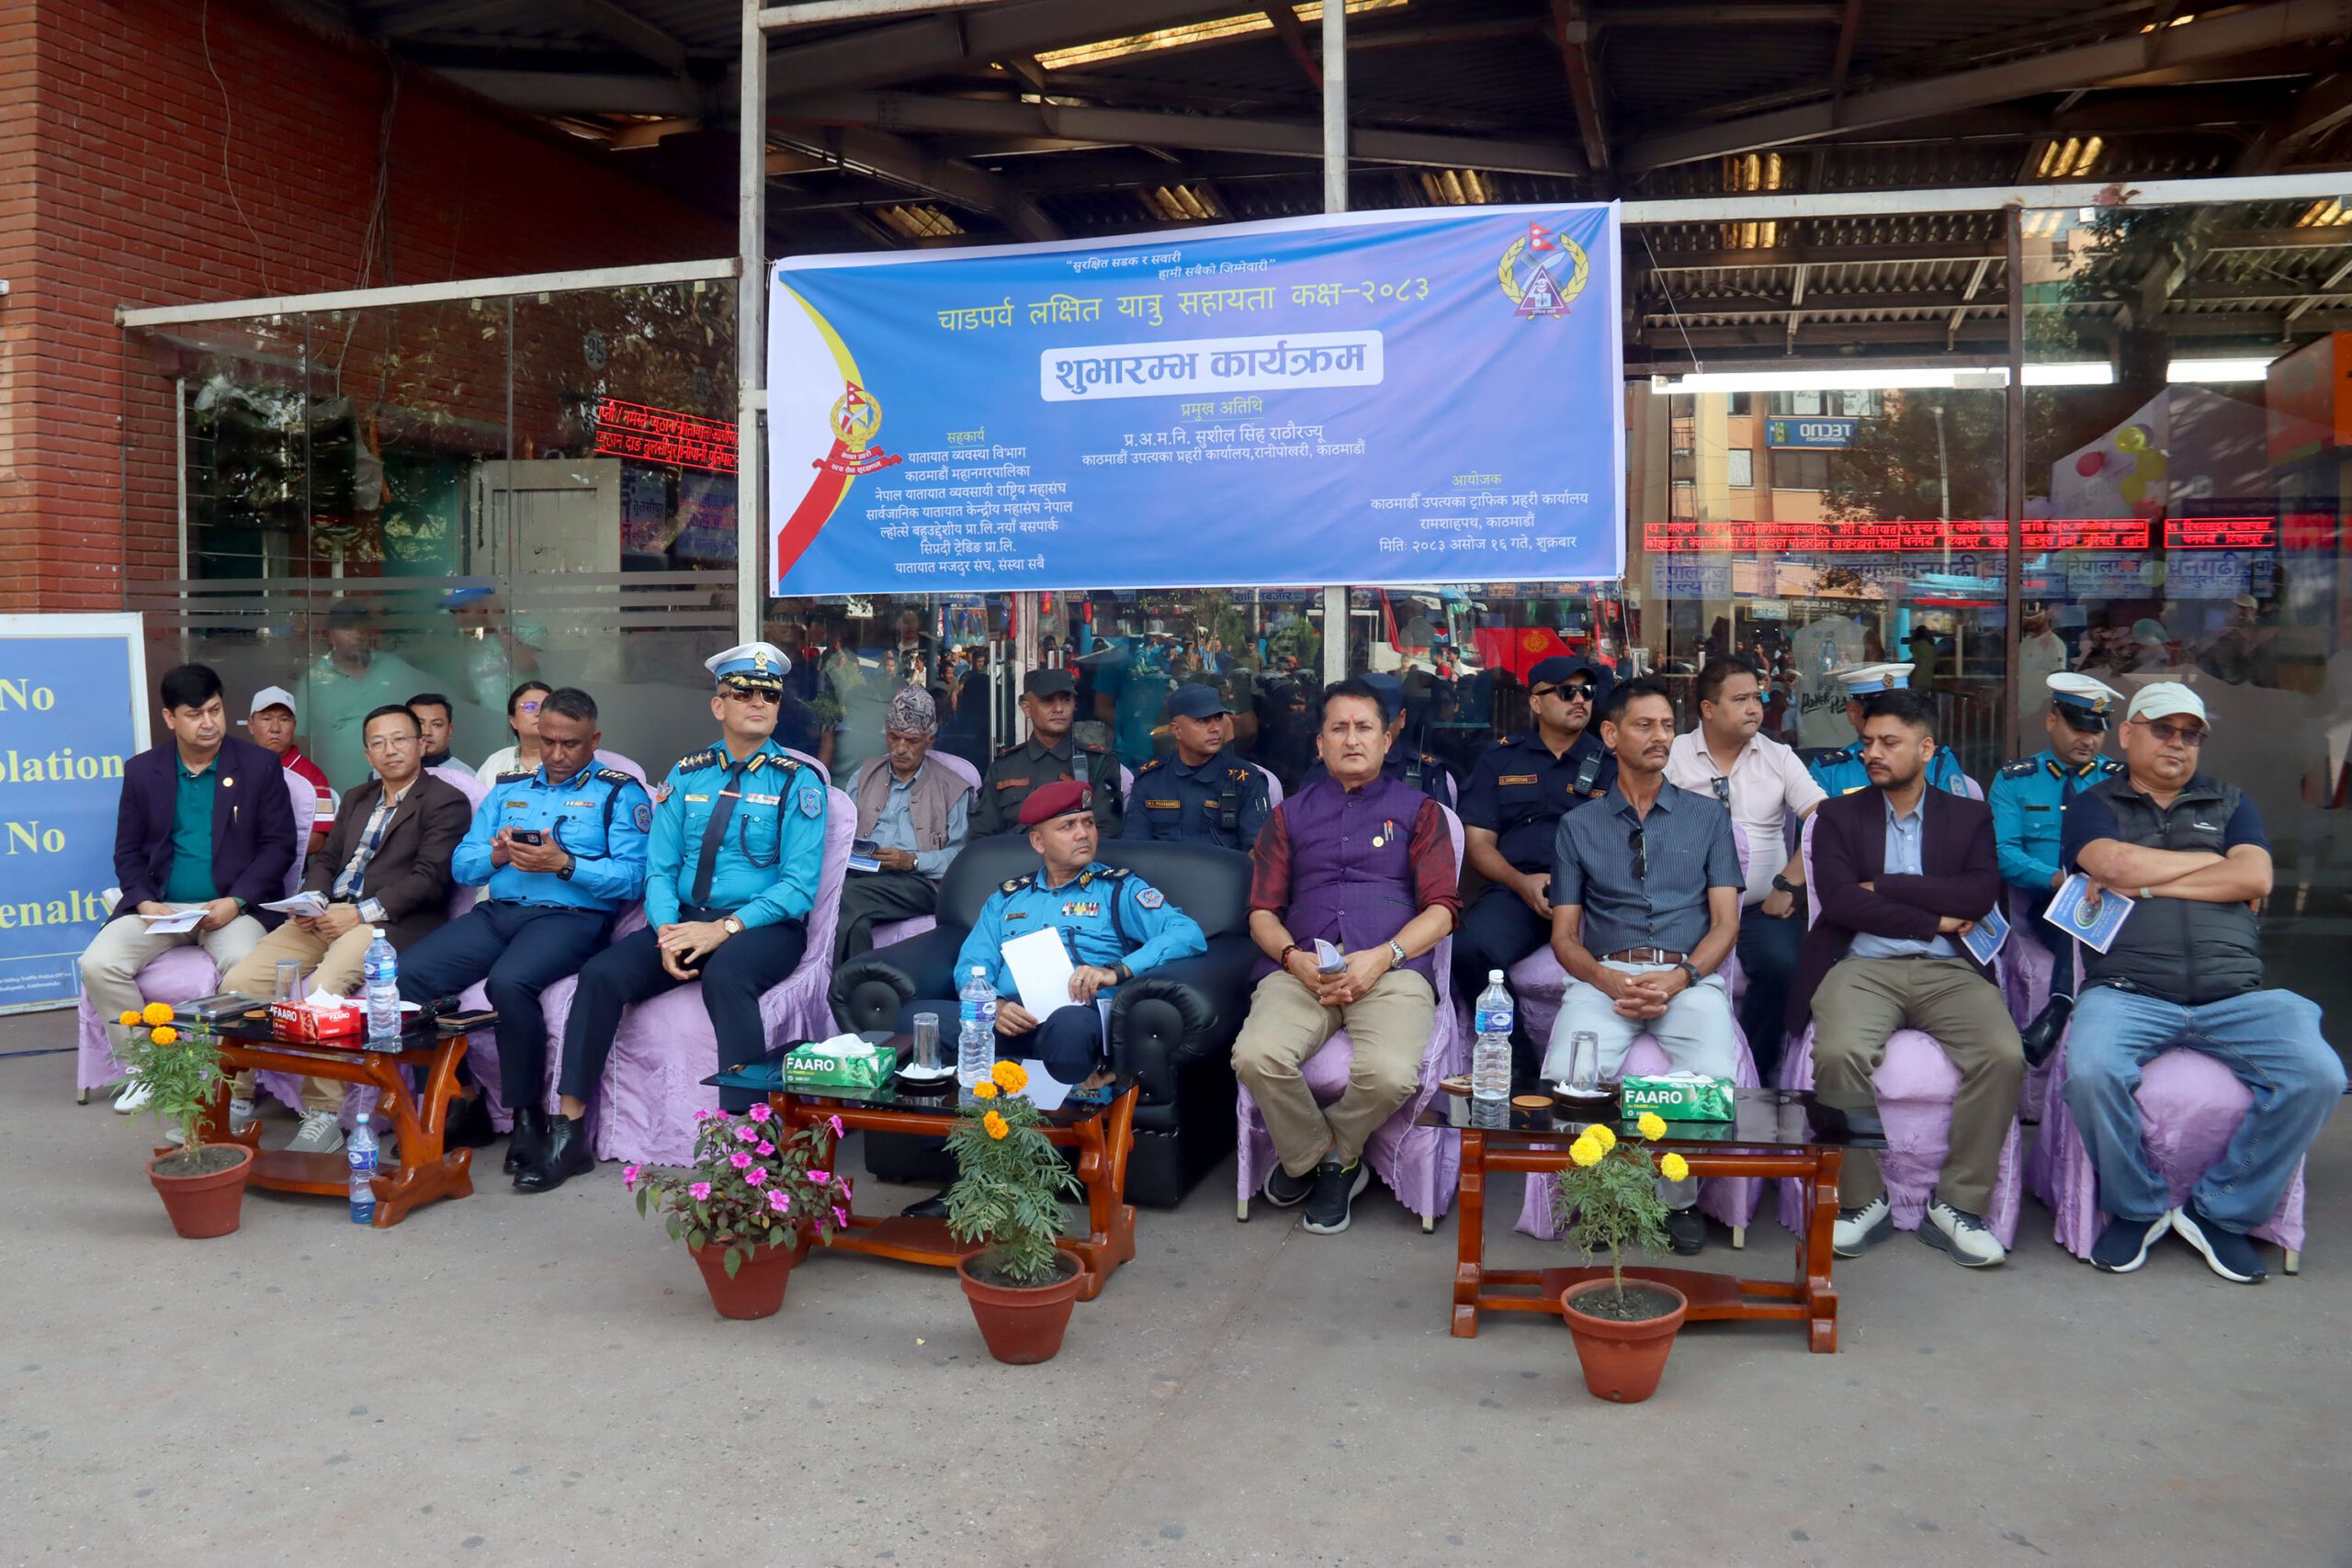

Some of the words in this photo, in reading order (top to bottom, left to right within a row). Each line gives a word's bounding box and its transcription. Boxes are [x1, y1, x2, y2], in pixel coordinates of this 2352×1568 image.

[1112, 255, 1138, 268] सडक
[1142, 255, 1148, 266] र
[1150, 250, 1182, 265] सवारी
[1158, 267, 1182, 282] हामी
[1185, 262, 1216, 277] सबैको
[937, 297, 1014, 331] चाडपर्व
[1027, 293, 1102, 325] लक्षित
[1116, 294, 1164, 326] यात्रु
[1177, 286, 1277, 317] सहायता
[1055, 353, 1199, 395] शुभारम्भ
[1210, 339, 1367, 378] कार्यक्रम
[1180, 400, 1215, 422] प्रमुख
[1219, 395, 1264, 415] अतिथि
[946, 426, 985, 443] सहकार्य
[1124, 426, 1191, 447] प्र.अ.म.नि.
[1195, 423, 1235, 448] सुशील
[1240, 423, 1265, 445] सिंह
[908, 451, 949, 464] यातायात
[952, 448, 989, 460] व्यवस्था
[992, 445, 1026, 459] विभाग
[1130, 448, 1173, 465] उपत्यका
[1176, 445, 1202, 465] प्रहरी
[952, 462, 1030, 481] महानगरपालिका
[1452, 471, 1502, 487] आयोजक
[875, 487, 902, 502] नेपाल
[905, 488, 946, 501] यातायात
[949, 481, 993, 499] व्यवसायी
[997, 481, 1025, 501] राष्ट्रिय
[1029, 480, 1067, 497] महासंघ
[1422, 494, 1466, 509] उपत्यका
[1470, 491, 1508, 510] ट्राफिक
[1511, 491, 1538, 508] प्रहरी
[1542, 489, 1589, 505] कार्यालय
[922, 505, 963, 518] यातायात
[967, 501, 1000, 518] केन्द्रीय
[1003, 502, 1040, 517] महासंघ
[1044, 498, 1073, 513] नेपाल
[1019, 515, 1058, 534] बसपार्क
[920, 540, 951, 557] सिप्रदी
[1412, 539, 1446, 553] २०८३
[1451, 536, 1487, 550] असोज
[1490, 538, 1507, 552] १६
[1510, 534, 1532, 551] गते,
[895, 561, 935, 574] यातायात
[938, 560, 970, 577] मजदुर
[973, 558, 995, 573] संघ,
[998, 557, 1024, 570] संस्था
[1028, 554, 1046, 570] सबै
[0, 679, 55, 711] No
[0, 748, 125, 783] lation
[7, 821, 65, 855] No
[273, 1006, 297, 1022] FAARO
[329, 1012, 350, 1021] FAARO
[786, 1057, 835, 1072] FAARO
[1625, 1090, 1683, 1104] FAARO
